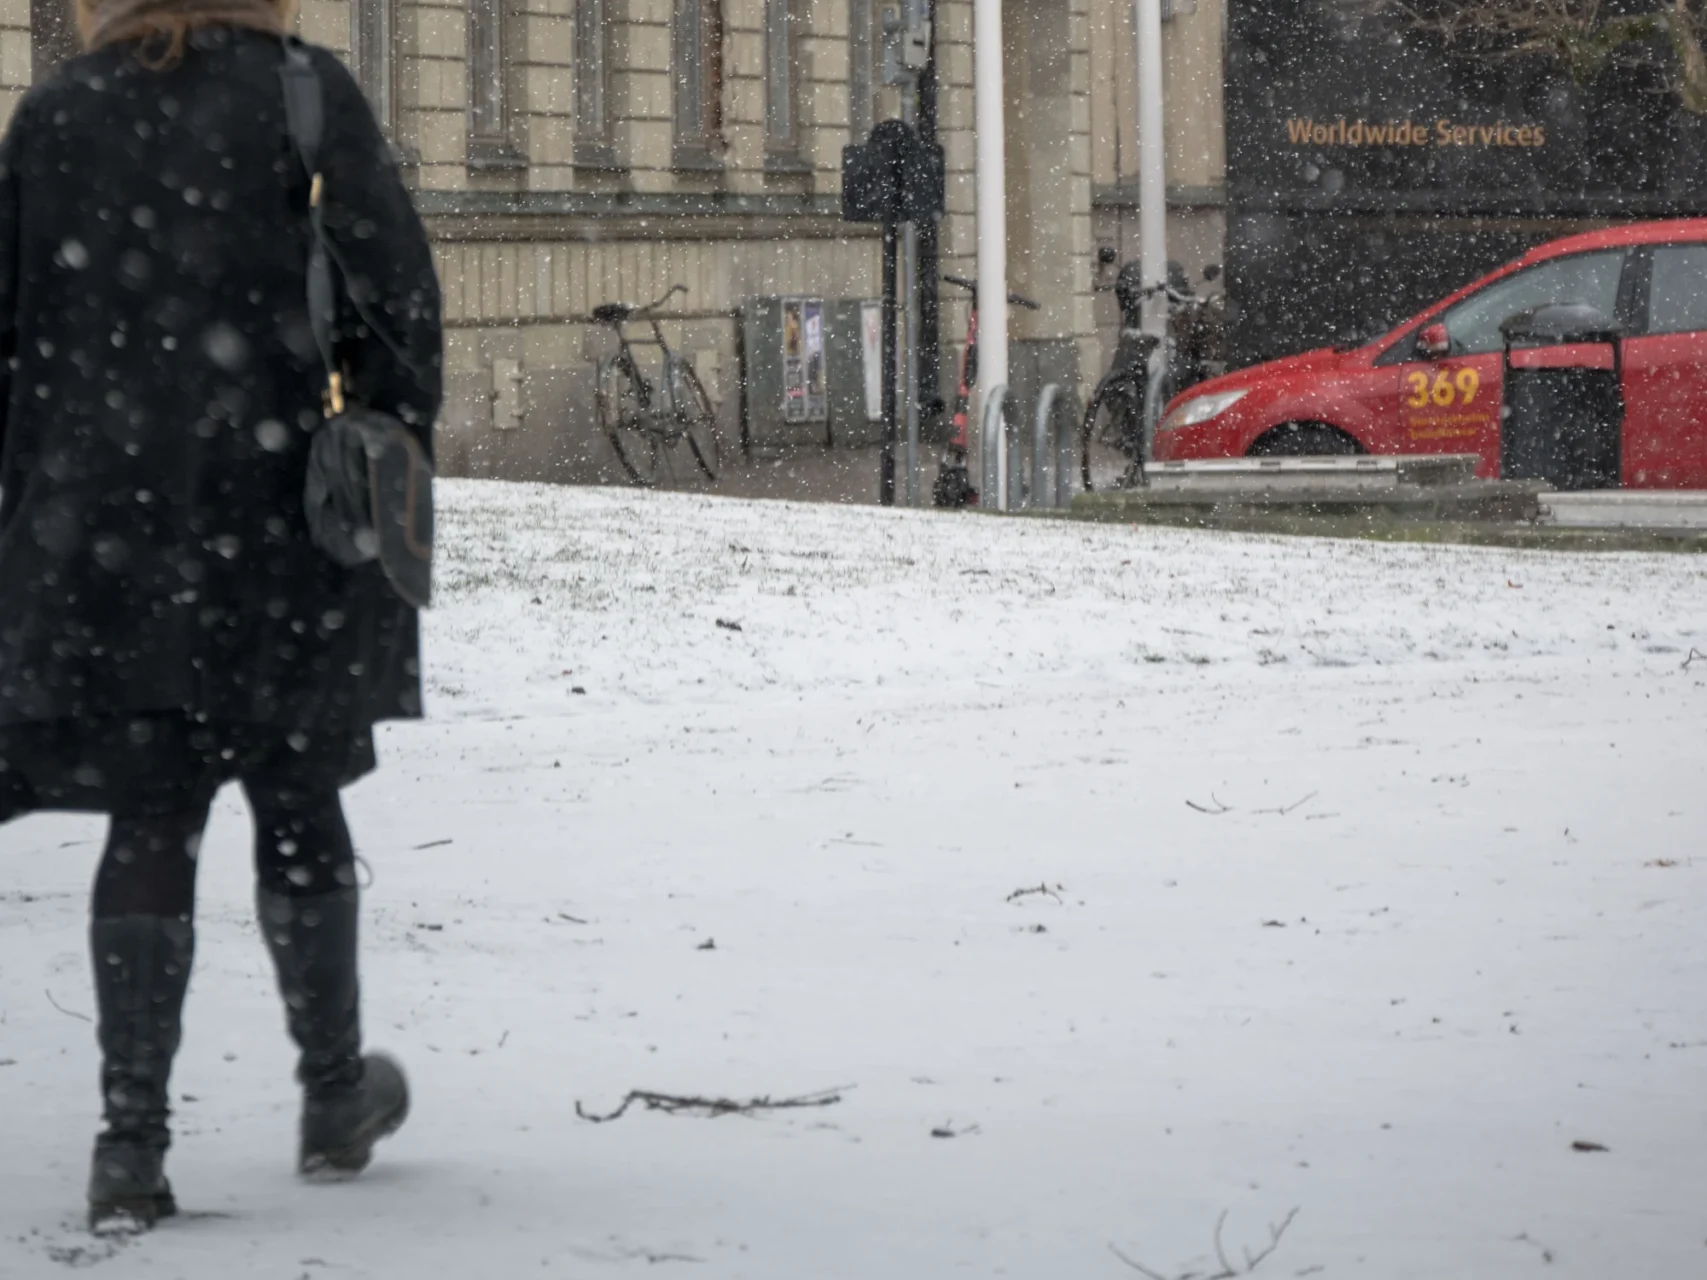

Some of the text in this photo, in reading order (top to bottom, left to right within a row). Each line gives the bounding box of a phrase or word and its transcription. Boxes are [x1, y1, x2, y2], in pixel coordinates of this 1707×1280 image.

[1287, 118, 1546, 147] Worldwide Services
[1407, 367, 1479, 409] 369
